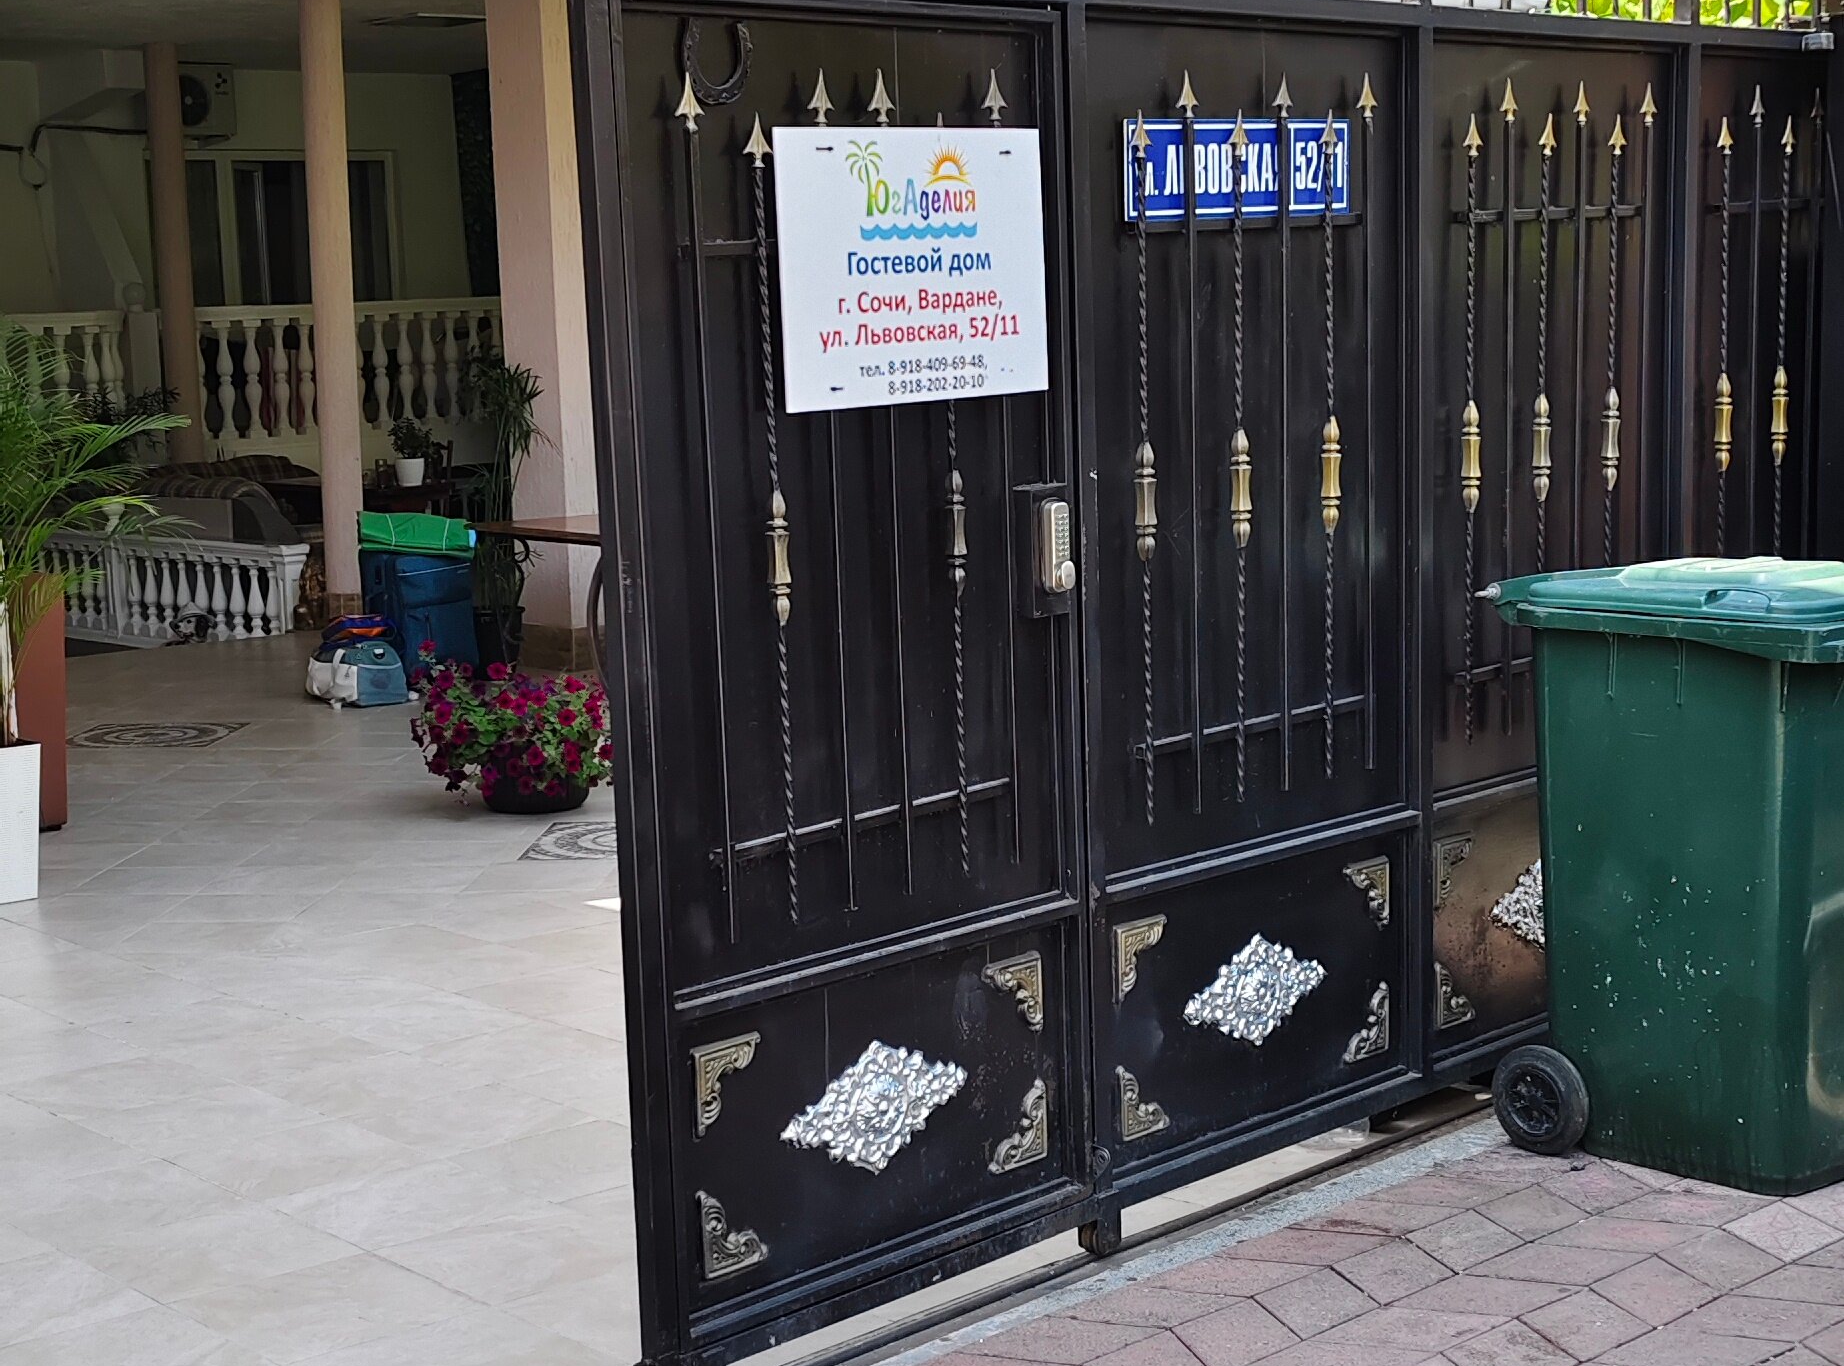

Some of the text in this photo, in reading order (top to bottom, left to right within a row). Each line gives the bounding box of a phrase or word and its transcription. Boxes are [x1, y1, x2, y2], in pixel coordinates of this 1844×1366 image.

[1134, 161, 1159, 197] Л.
[1163, 142, 1279, 196] ЛВОВСКА
[847, 247, 992, 277] Гостевой дом
[838, 288, 1003, 316] г. Сочи, Вардане,
[819, 313, 1020, 354] ул. Львовская, 52/11
[859, 353, 988, 378] тел. 8-918-409-69-48,
[888, 373, 985, 396] 8-918-202-20-10
